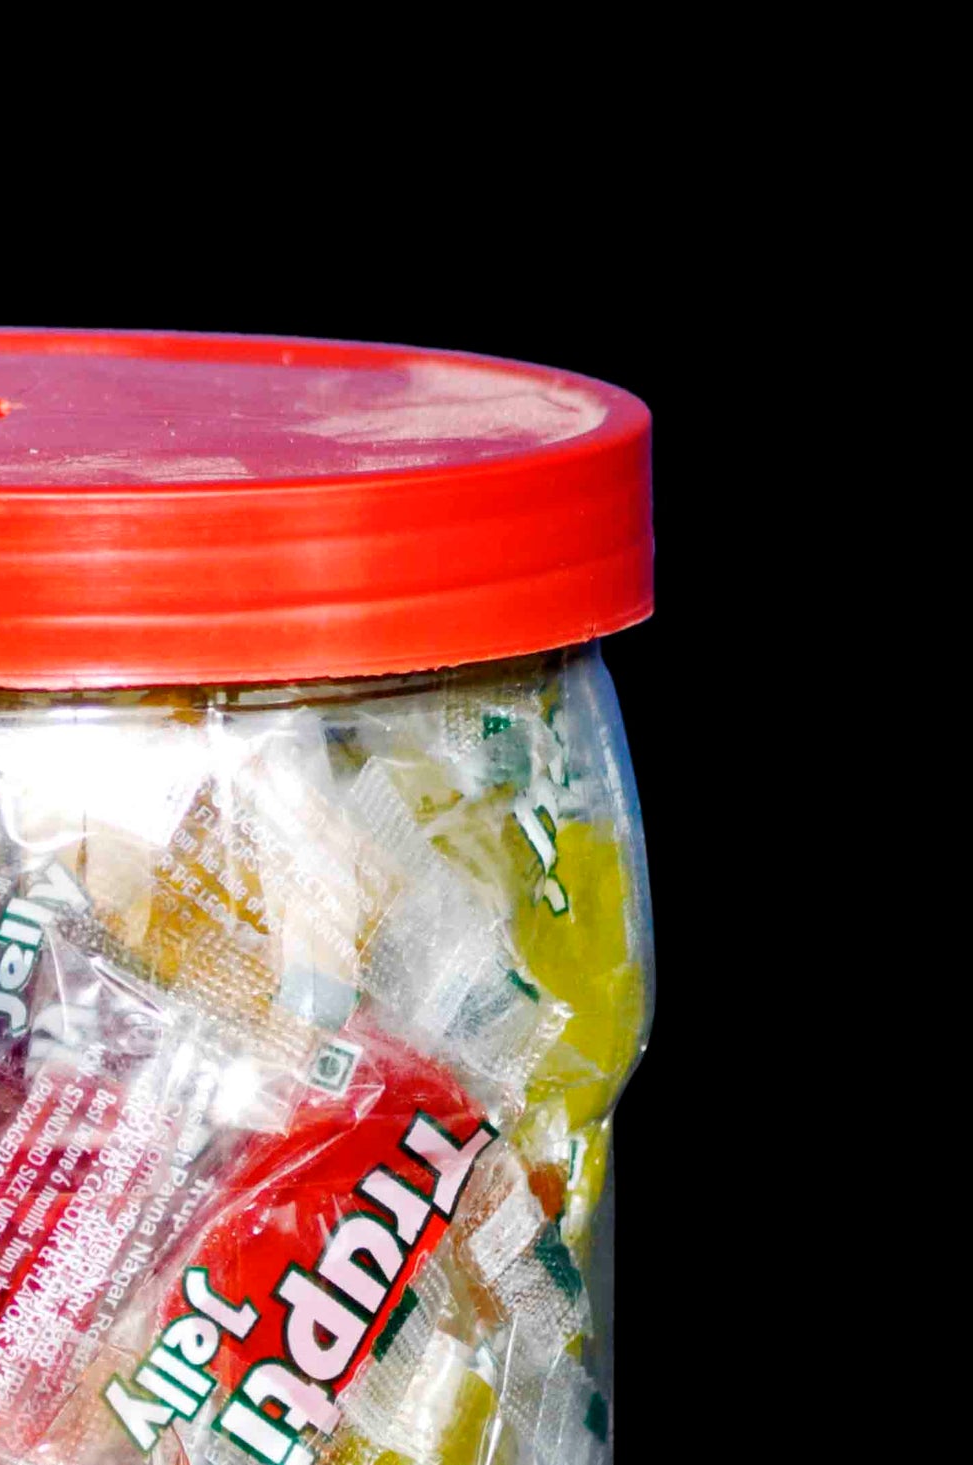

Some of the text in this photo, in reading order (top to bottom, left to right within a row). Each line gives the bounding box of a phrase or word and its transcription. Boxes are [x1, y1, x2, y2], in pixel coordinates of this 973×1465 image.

[22, 1082, 87, 1168] STANDARD
[3, 1163, 38, 1203] SIZE
[15, 1183, 63, 1242] months
[96, 1163, 190, 1310] Pavna Nagar
[100, 1265, 261, 1455] Jelly
